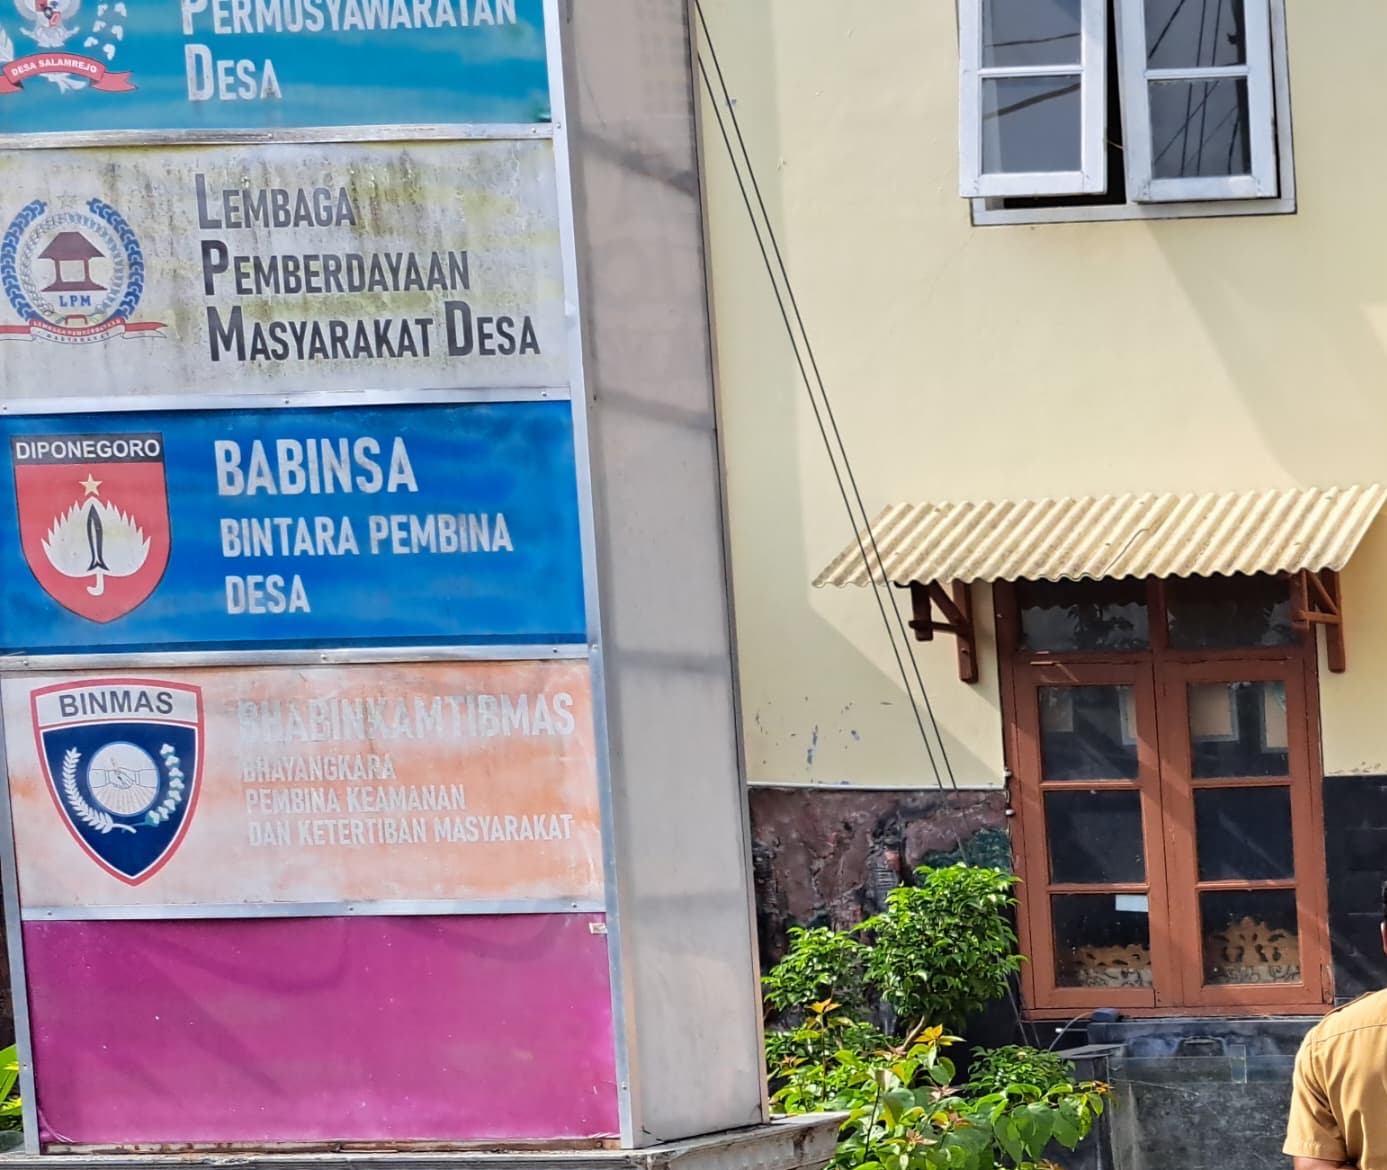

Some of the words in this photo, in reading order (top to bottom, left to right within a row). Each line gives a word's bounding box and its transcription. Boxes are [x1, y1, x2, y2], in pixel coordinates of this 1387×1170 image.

[182, 0, 517, 35] PERMUSYAWARATAN
[11, 62, 37, 76] DESA
[38, 58, 98, 74] SALAMREJO
[185, 44, 283, 101] DESA
[194, 173, 357, 231] LEMBAGA
[202, 239, 470, 297] PEMBERDAYAAN
[59, 295, 92, 308] LPM
[206, 305, 434, 362] MASYARAKAT
[444, 300, 541, 357] DESA
[15, 438, 161, 460] DIPONEGORO
[214, 436, 418, 496] BABINSA
[220, 516, 360, 558] BINTARA
[369, 512, 514, 555] PEMBINA
[225, 574, 311, 615] DESA
[58, 690, 174, 718] BINMAS
[242, 753, 397, 783] BHAYANGKARA
[245, 787, 341, 816] PEMBINA
[347, 783, 466, 813] KEAMANAN
[248, 820, 291, 848] DAN
[299, 816, 426, 846] KETERTIBAN
[433, 813, 573, 843] MASYARAKAT
